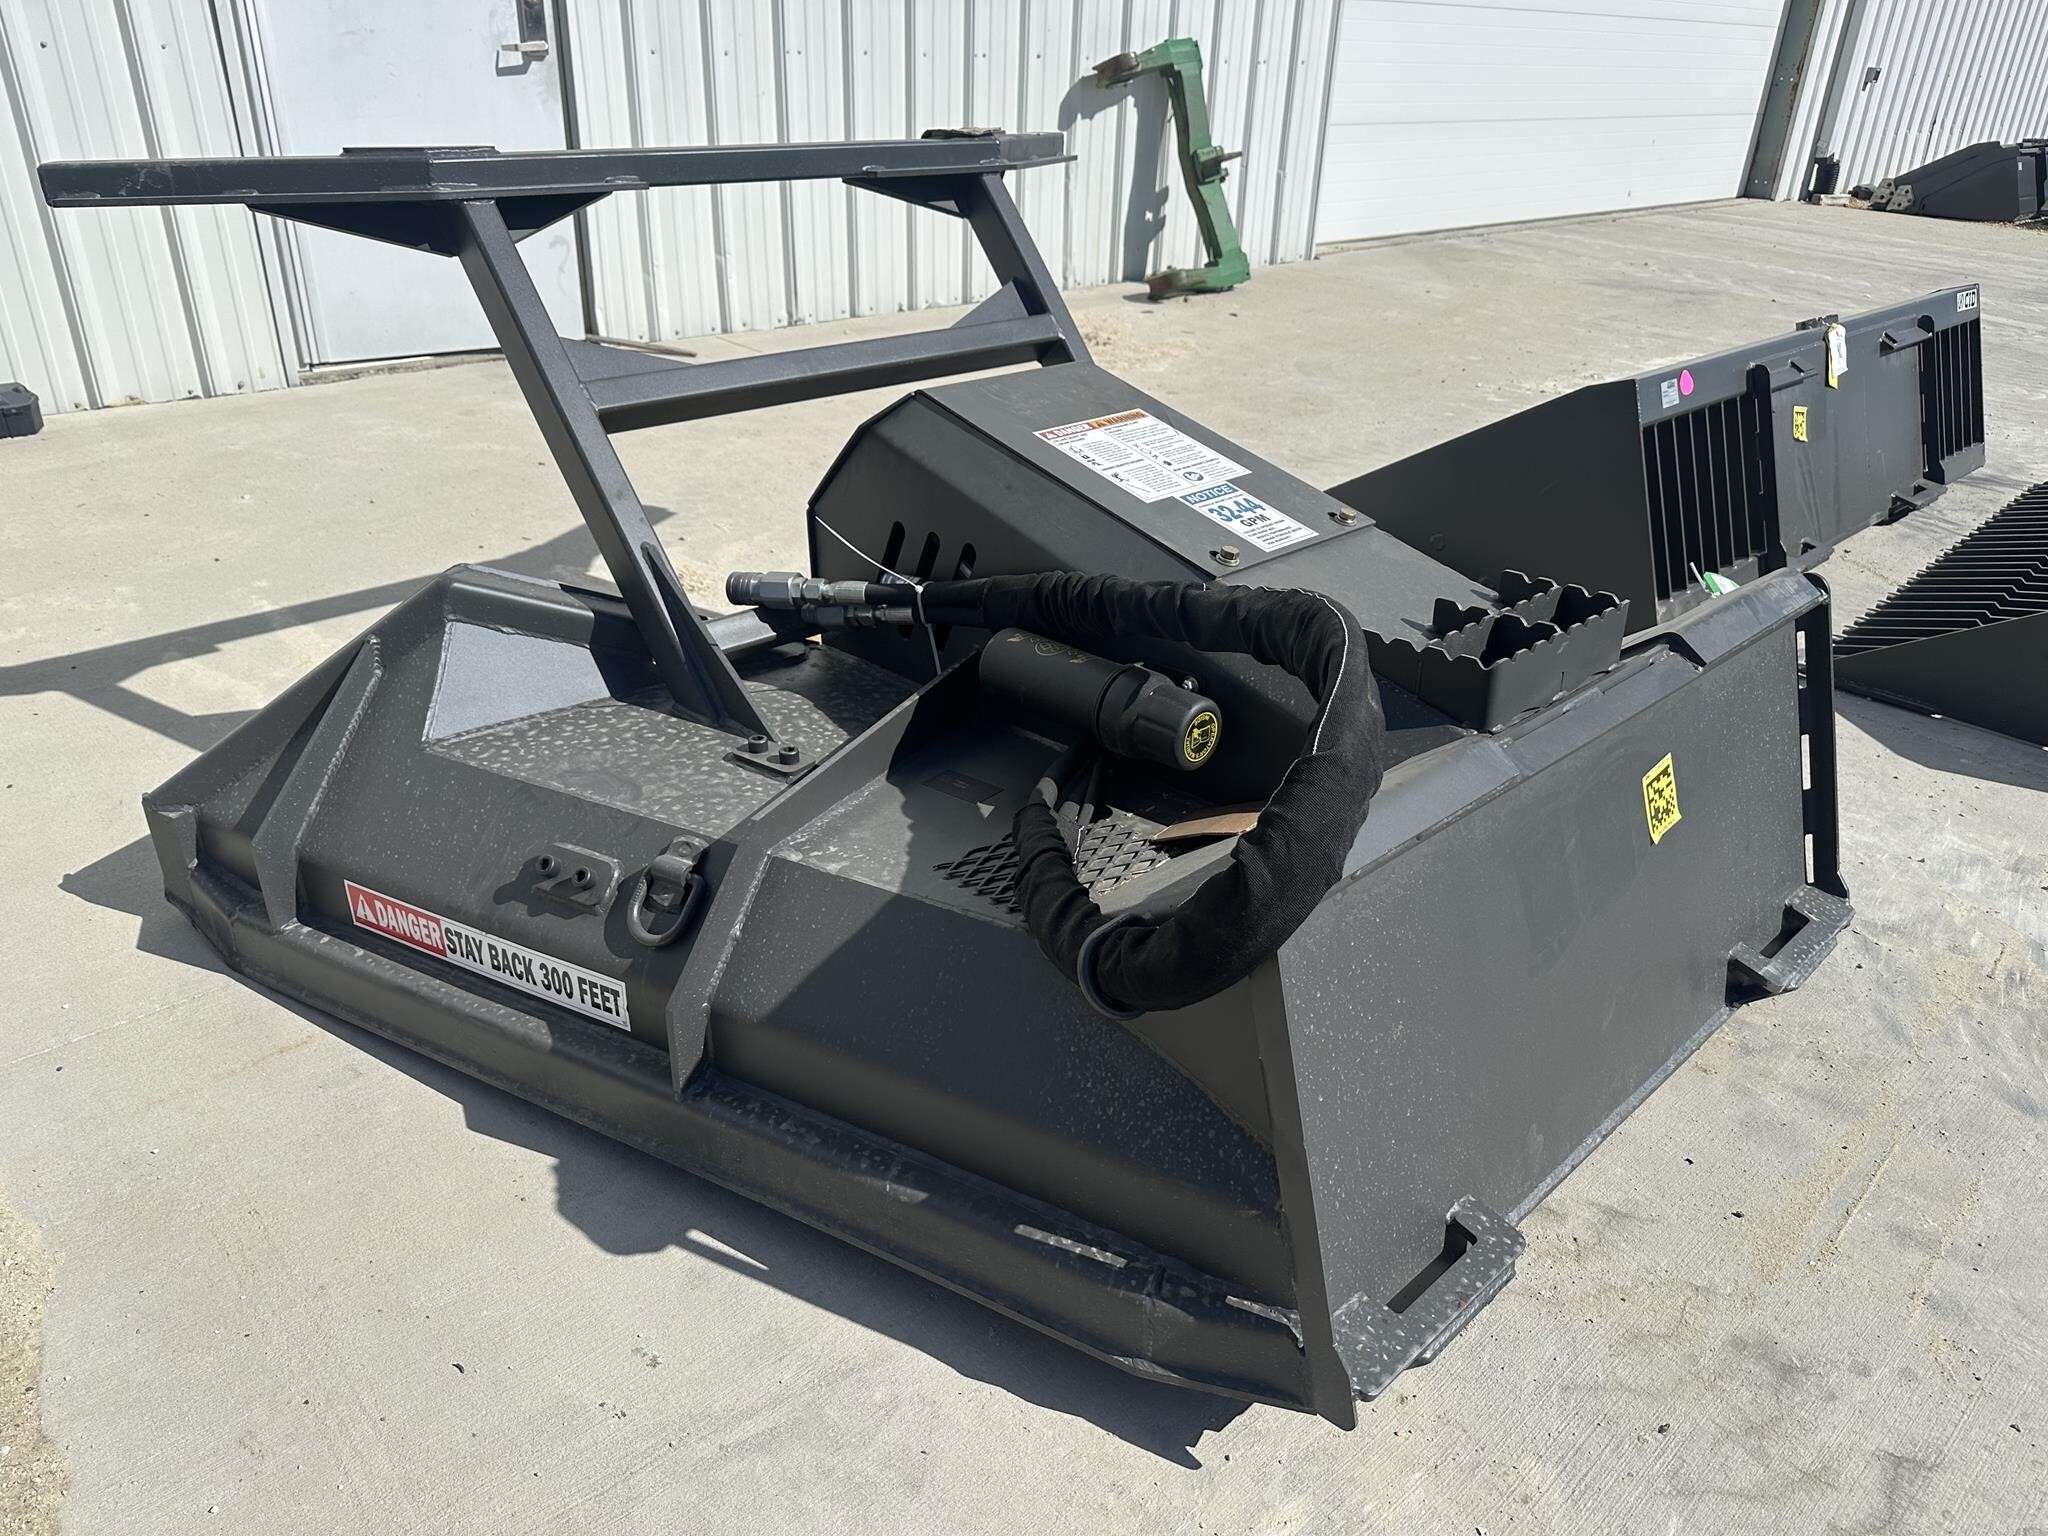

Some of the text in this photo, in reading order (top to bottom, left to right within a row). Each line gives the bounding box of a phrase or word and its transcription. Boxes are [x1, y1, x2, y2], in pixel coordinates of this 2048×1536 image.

[1103, 411, 1145, 424] WARNING
[1054, 422, 1093, 437] DANGER
[1186, 484, 1233, 503] NOTICE
[1208, 498, 1266, 523] 32-44
[1240, 514, 1271, 527] GPM
[374, 900, 621, 1017] DANGER STAY BACK 300 FEET
